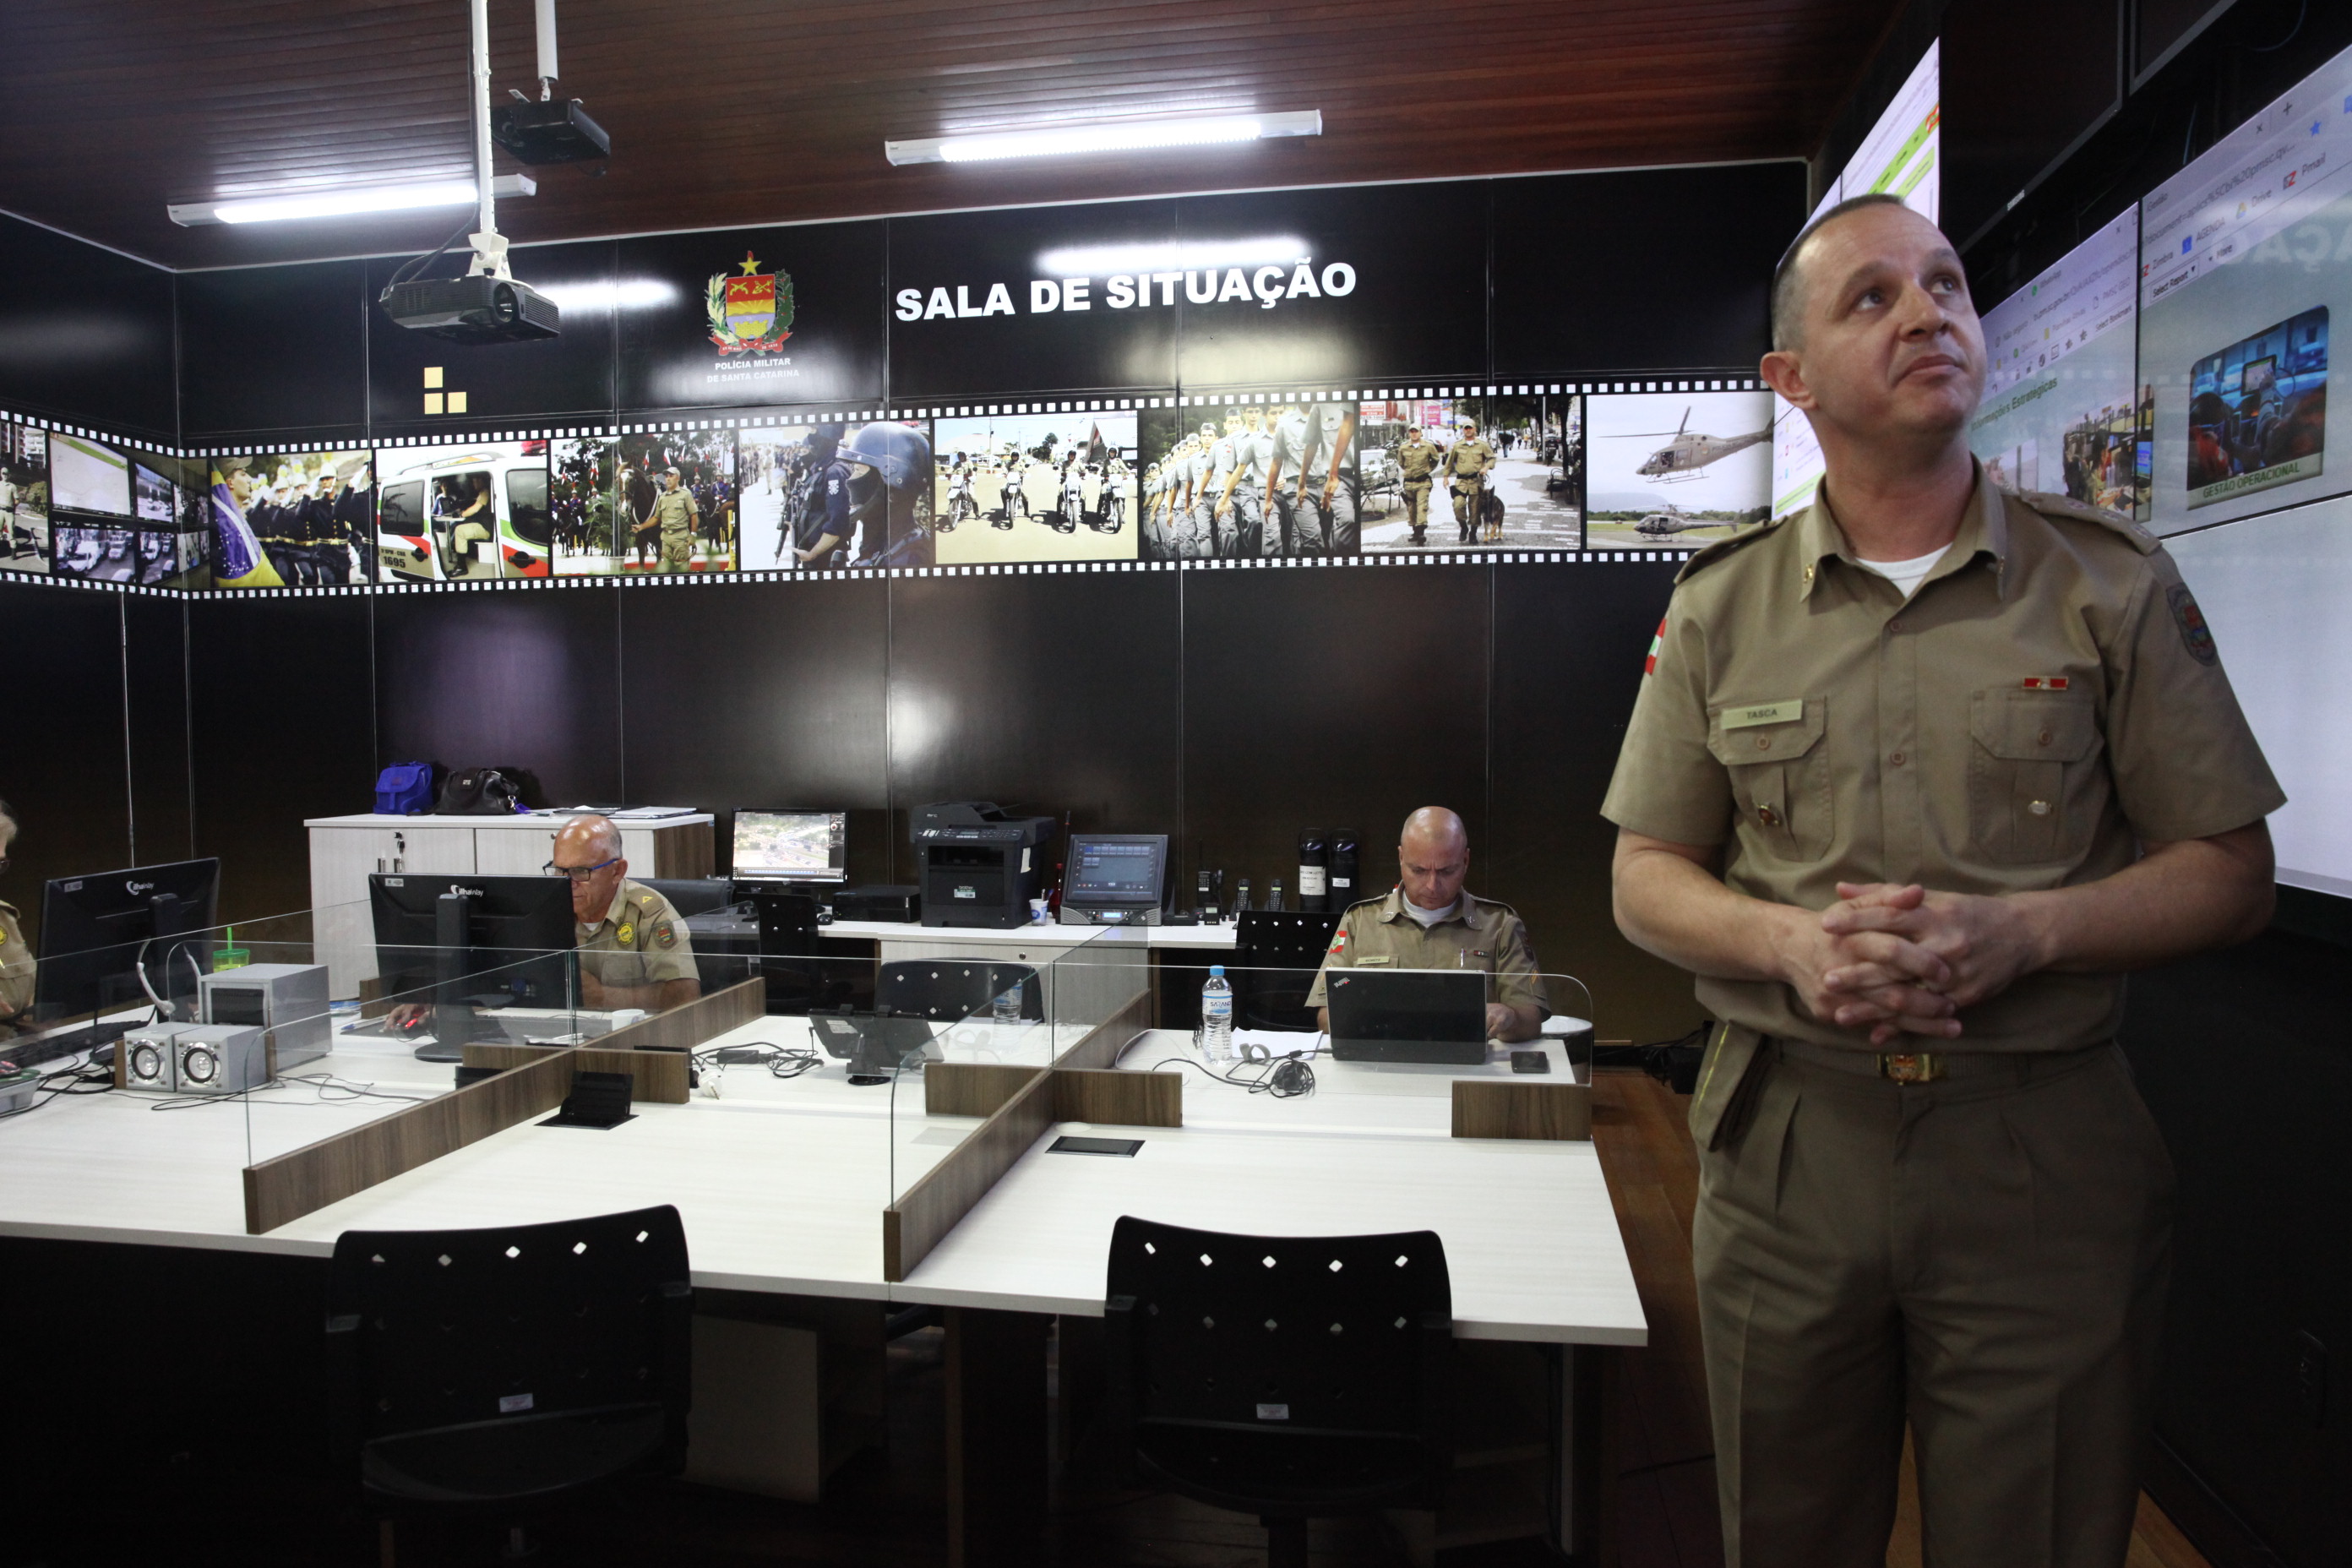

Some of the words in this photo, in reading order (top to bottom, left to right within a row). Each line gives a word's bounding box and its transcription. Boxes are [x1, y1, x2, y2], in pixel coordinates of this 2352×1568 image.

[895, 282, 1016, 322] SALA
[1030, 277, 1092, 314] DE
[1105, 256, 1357, 309] SITUAÇÃO
[2153, 280, 2170, 298] Select
[2169, 270, 2189, 290] Report
[715, 360, 751, 371] POLÍCIA
[754, 357, 791, 368] MILITAR
[721, 373, 751, 382] SANTA
[754, 369, 799, 379] CATARINA
[2202, 480, 2235, 498] GESTÃO
[2237, 461, 2300, 489] OPERACIONAL
[384, 556, 406, 569] 1695
[1746, 709, 1778, 719] TASCA
